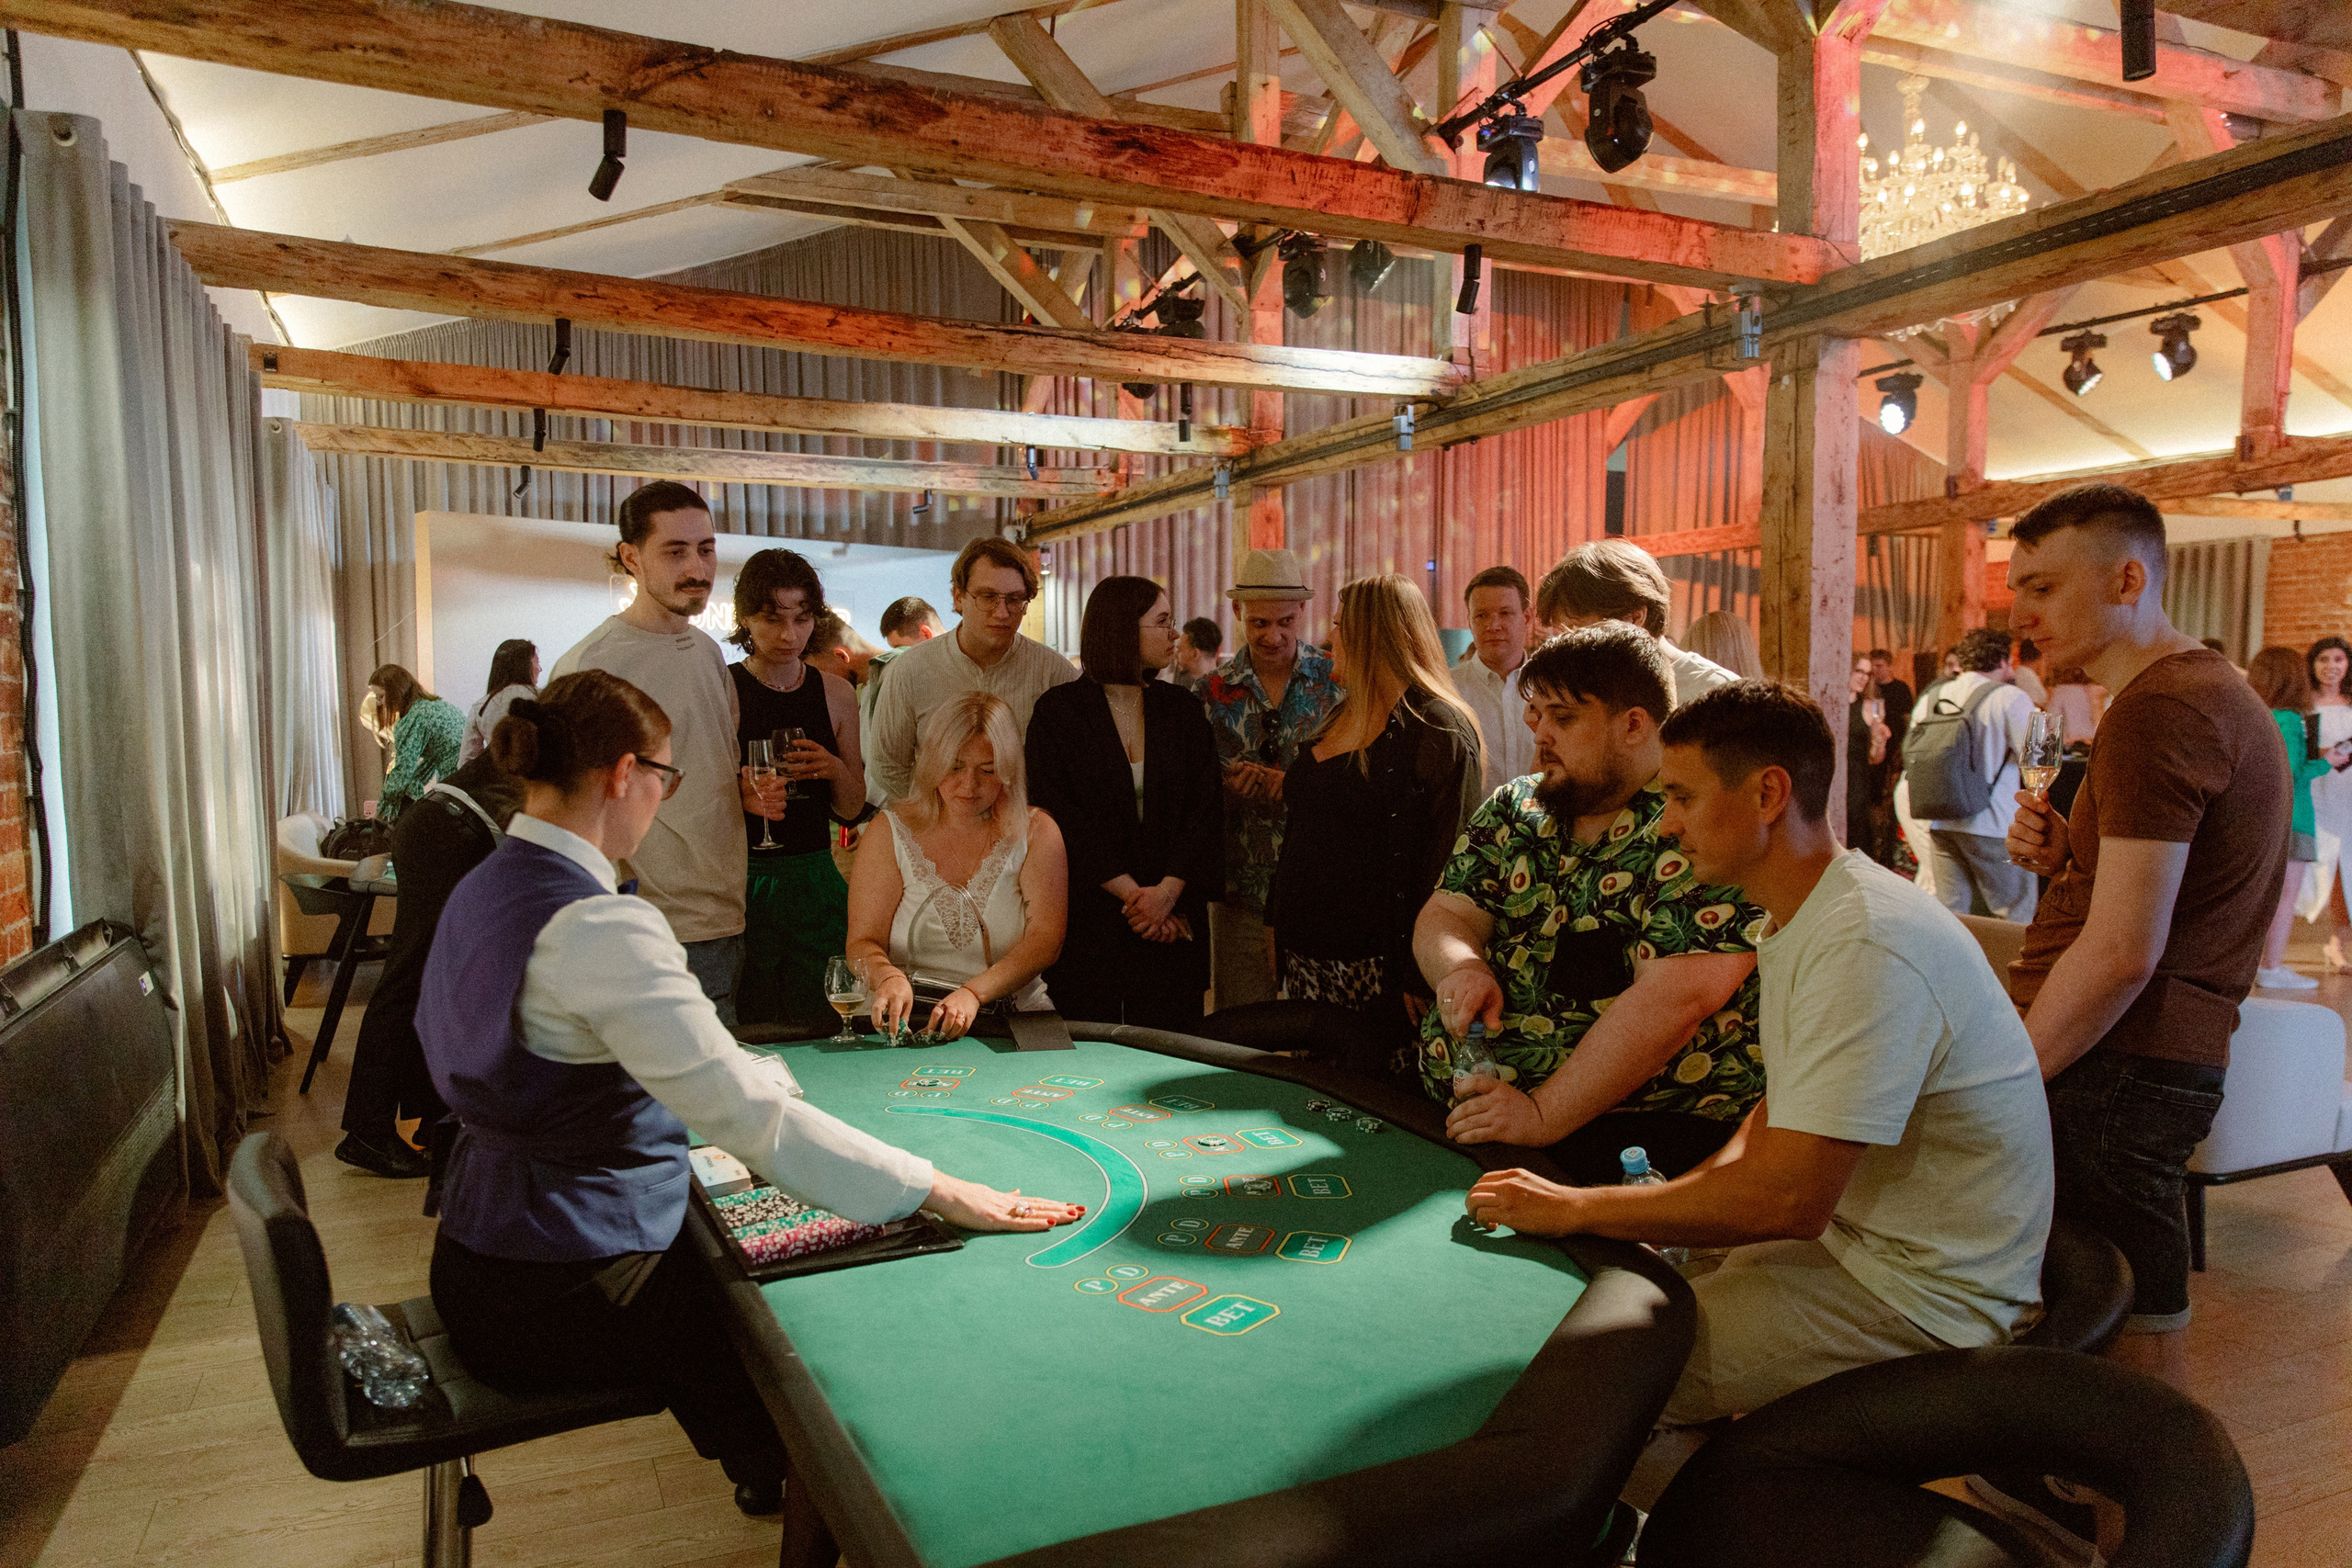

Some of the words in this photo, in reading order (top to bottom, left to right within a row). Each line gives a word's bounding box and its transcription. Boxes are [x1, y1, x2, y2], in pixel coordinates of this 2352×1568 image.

[1050, 1077, 1092, 1087] BET
[1020, 1089, 1065, 1099] ANTE
[1119, 1107, 1159, 1120] ANTE
[1251, 1131, 1286, 1145] BET
[1307, 1178, 1331, 1194] BET
[1179, 1220, 1201, 1228] D
[1165, 1235, 1187, 1243] P
[1226, 1226, 1255, 1249] ANTE
[1298, 1235, 1329, 1258] BET
[1115, 1266, 1140, 1277] D
[1083, 1280, 1106, 1292] P
[1138, 1280, 1190, 1306] ANTE
[1204, 1301, 1257, 1327] BET
